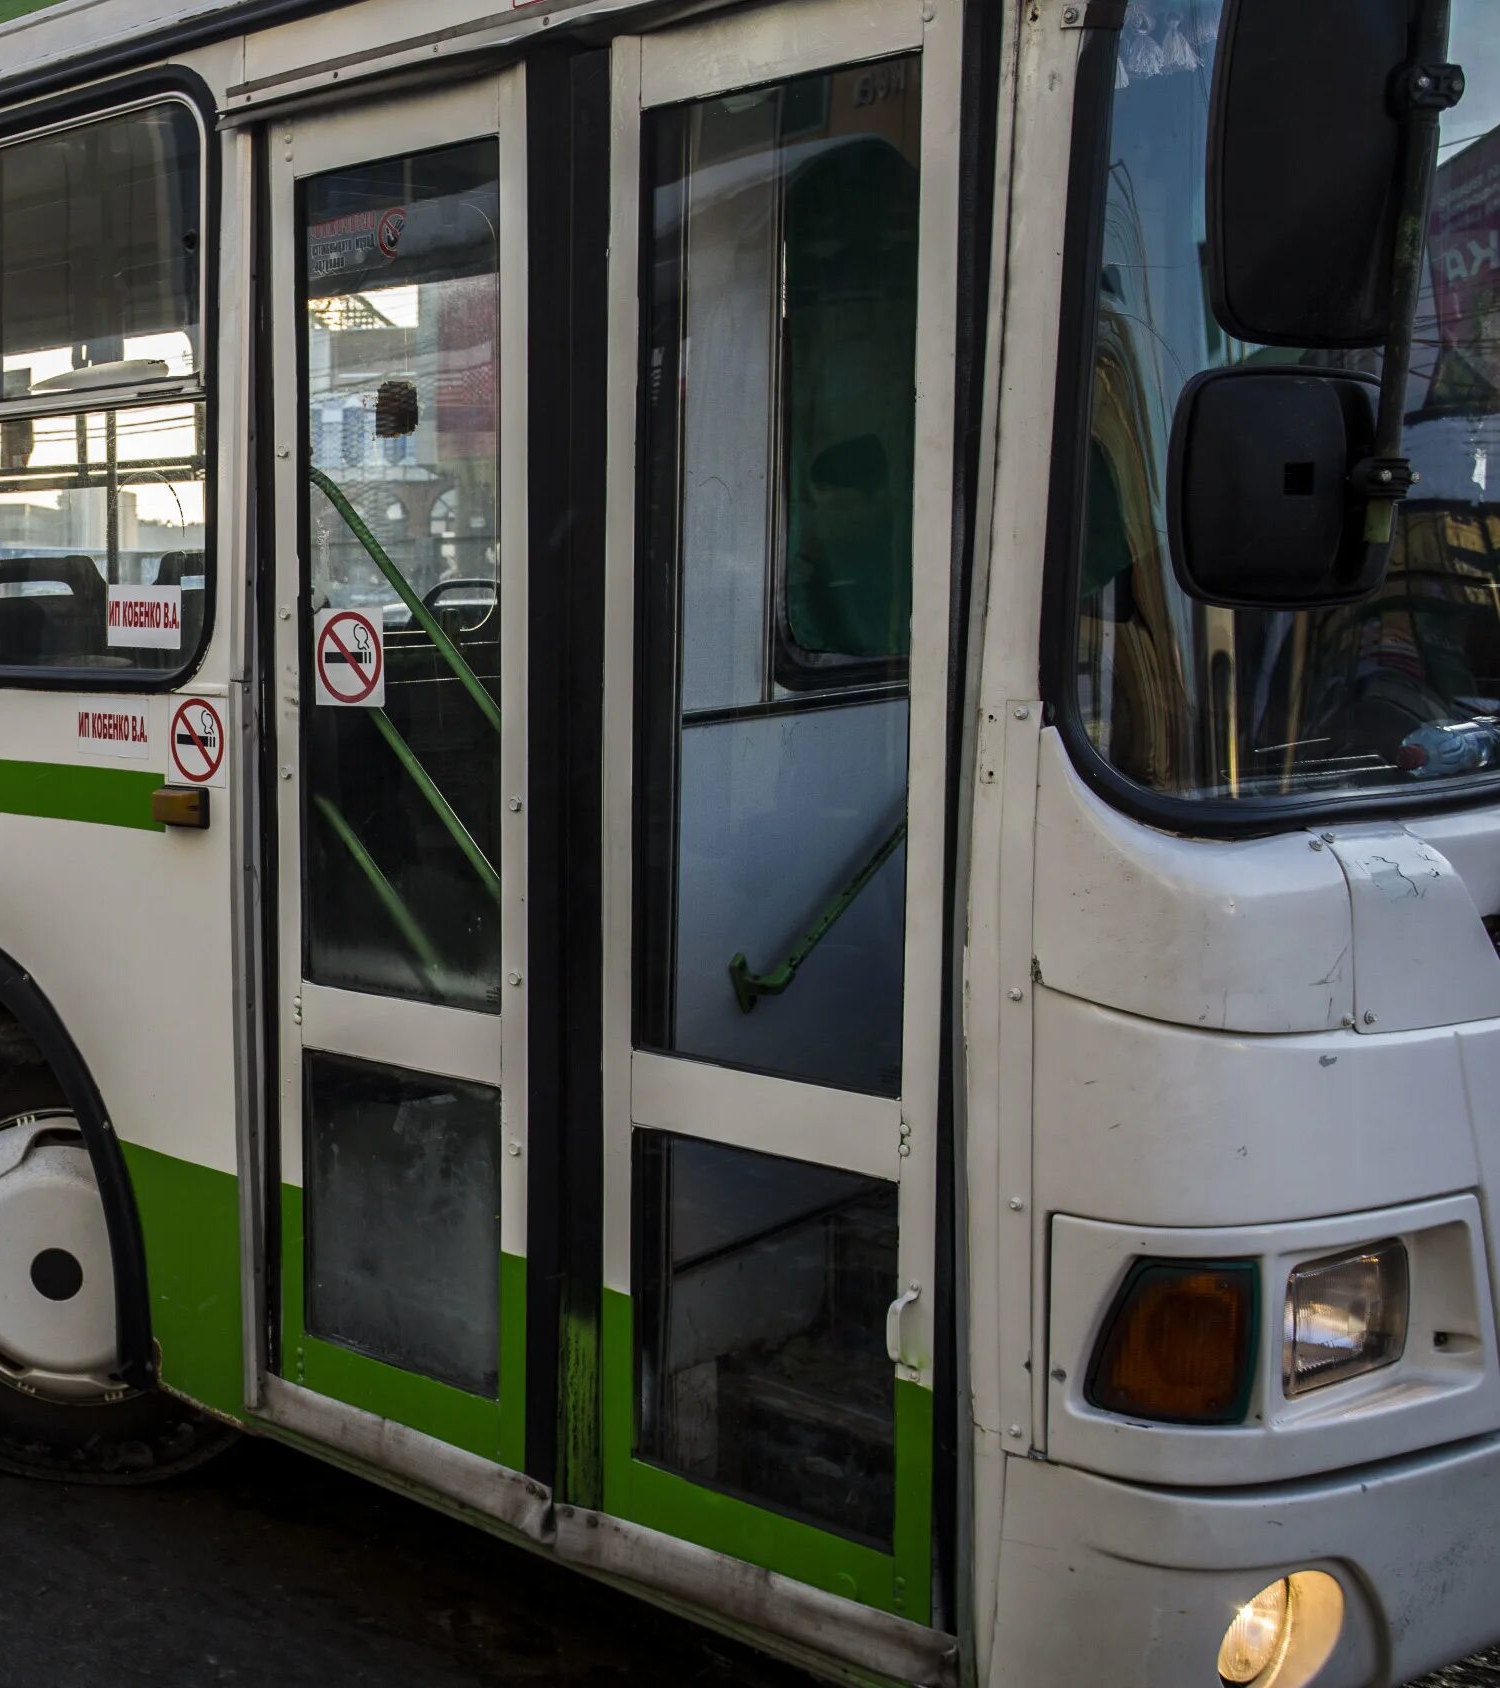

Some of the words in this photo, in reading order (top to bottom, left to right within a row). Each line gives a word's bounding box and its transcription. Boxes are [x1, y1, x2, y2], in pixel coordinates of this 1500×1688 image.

[108, 601, 120, 627] ИП
[122, 601, 161, 629] КОБЕНКО
[164, 602, 179, 629] В.А.
[78, 711, 90, 737] ИП
[91, 713, 129, 741] КОБЕНКО
[132, 716, 147, 742] В.А.
